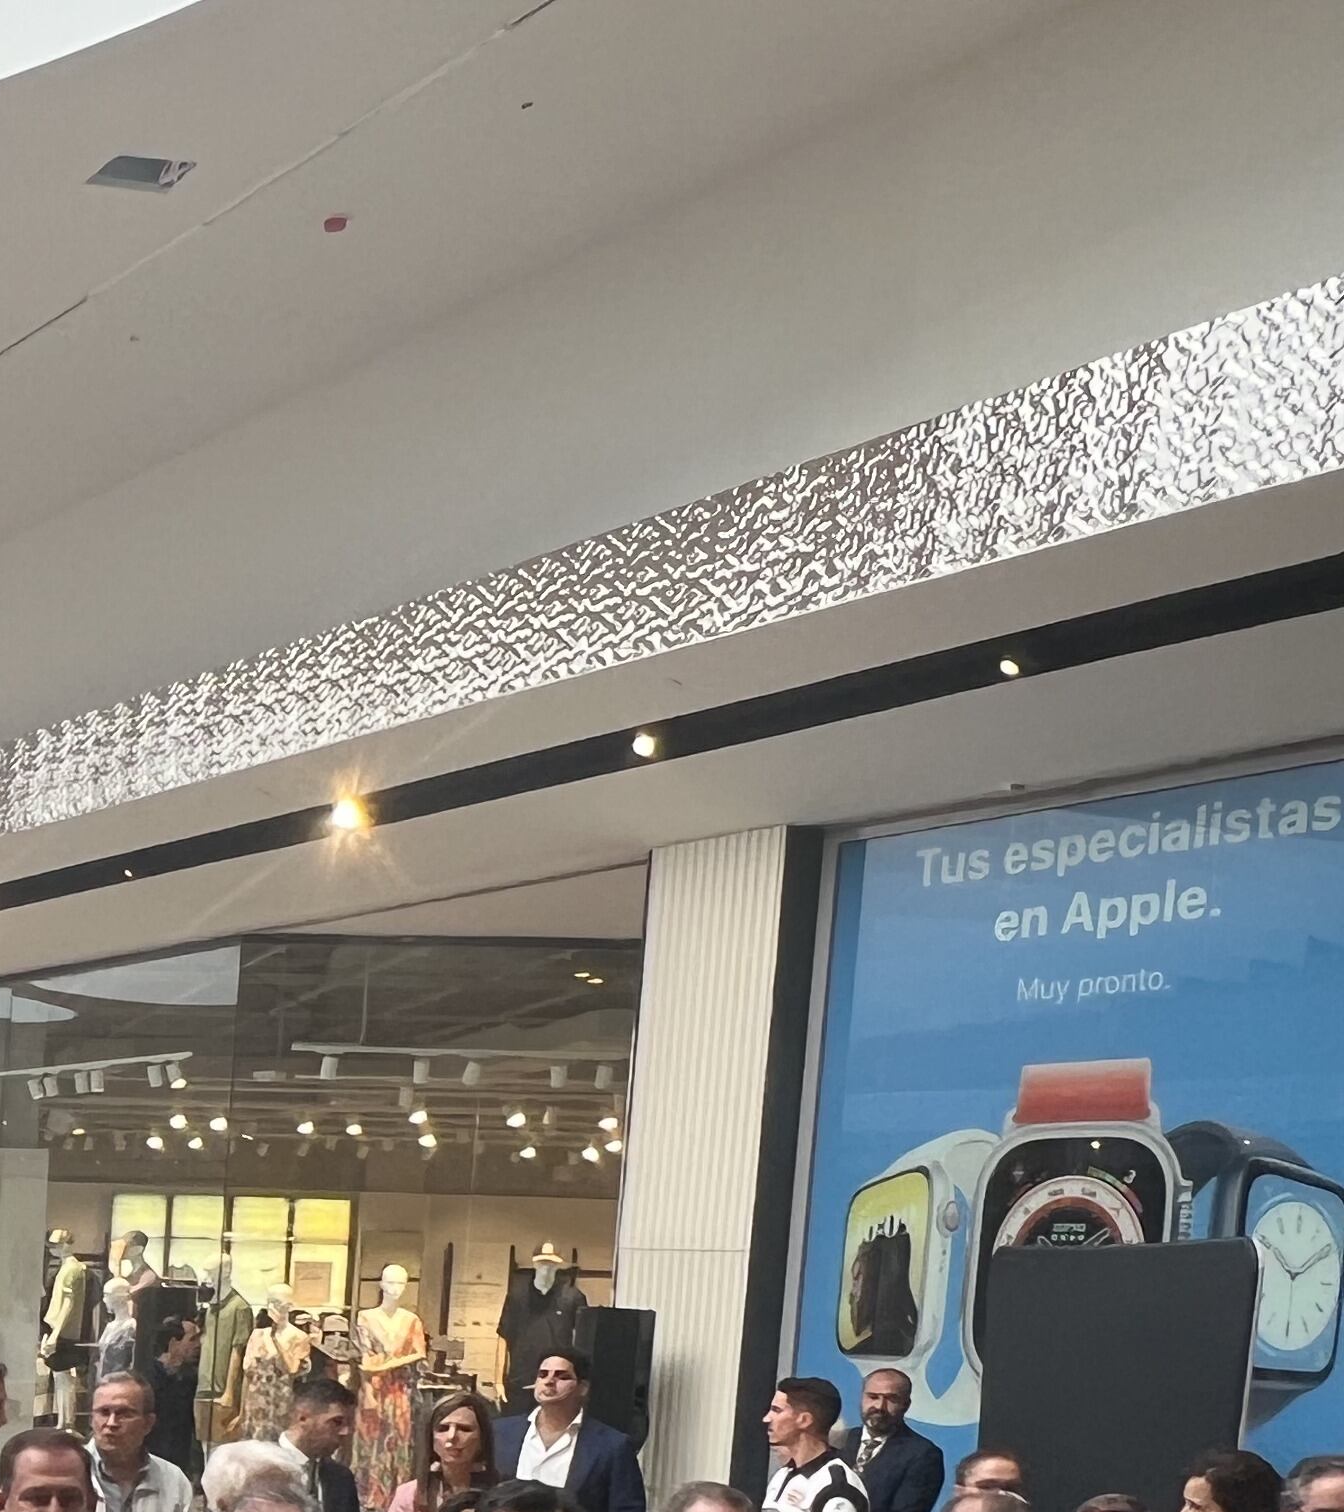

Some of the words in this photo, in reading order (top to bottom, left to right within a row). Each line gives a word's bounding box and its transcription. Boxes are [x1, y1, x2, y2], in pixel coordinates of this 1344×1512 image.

[916, 847, 990, 887] Tus
[1003, 796, 1342, 877] especialistas
[994, 905, 1048, 941] en
[1061, 879, 1221, 938] Apple.
[1017, 977, 1068, 1005] Muy
[1077, 969, 1172, 1003] pronto.
